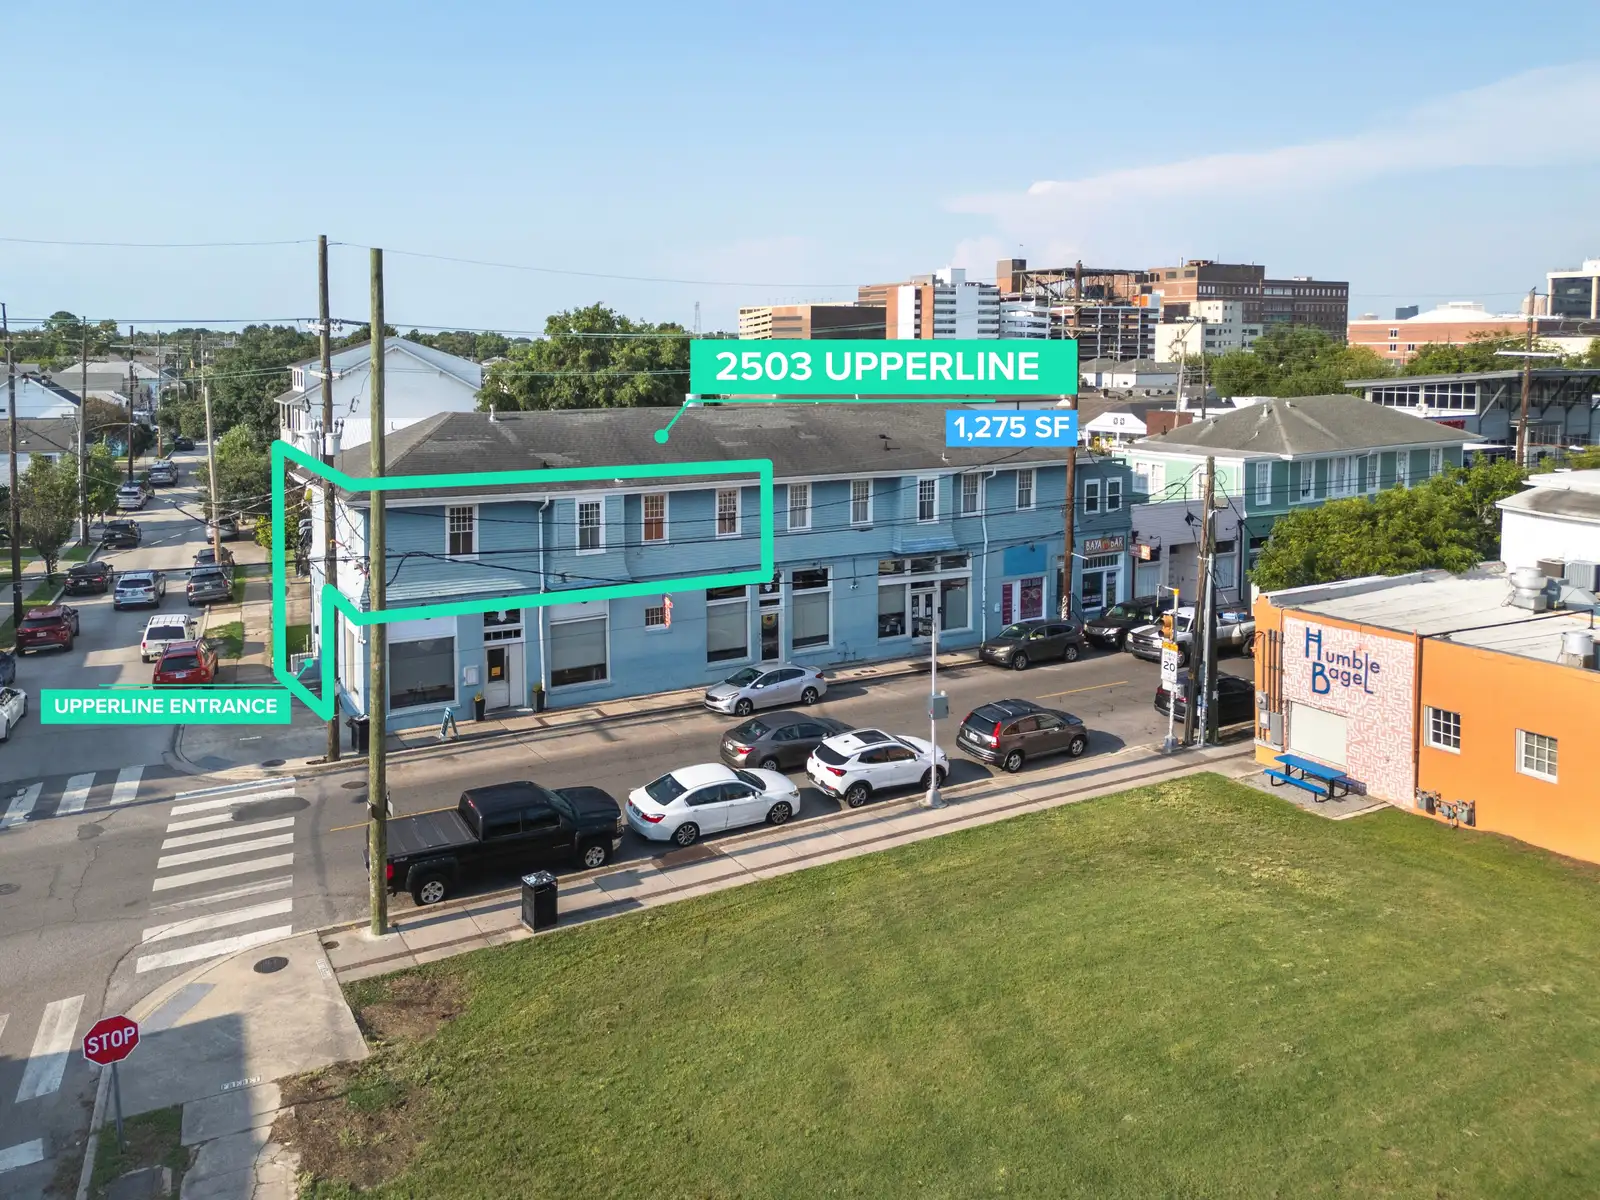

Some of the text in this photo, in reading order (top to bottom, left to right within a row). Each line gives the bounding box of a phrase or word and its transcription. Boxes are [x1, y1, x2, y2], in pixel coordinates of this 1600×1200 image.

[1305, 626, 1380, 673] Humble
[1163, 660, 1176, 672] 20
[87, 1026, 136, 1055] STOP
